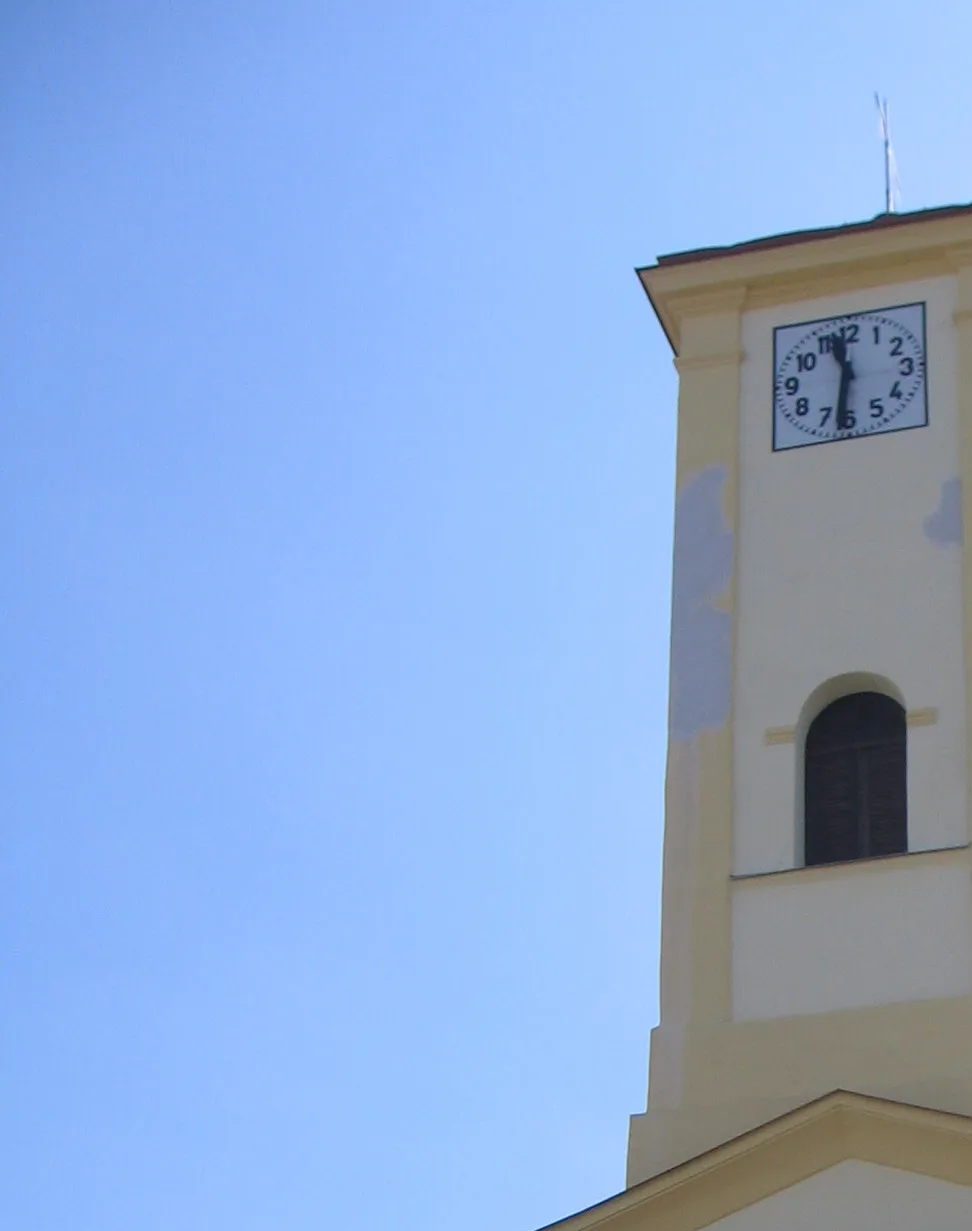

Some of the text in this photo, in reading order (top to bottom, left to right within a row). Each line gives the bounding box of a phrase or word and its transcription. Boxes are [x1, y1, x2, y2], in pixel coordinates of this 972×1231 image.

[839, 324, 860, 343] 12
[872, 326, 880, 345] 1
[818, 335, 831, 354] 11
[889, 337, 903, 357] 2
[796, 352, 817, 373] 10
[899, 357, 914, 376] 3
[785, 376, 799, 396] 9
[889, 380, 903, 400] 4
[795, 397, 809, 416] 8
[869, 398, 884, 418] 5
[819, 406, 833, 428] 7
[842, 410, 857, 430] 6
